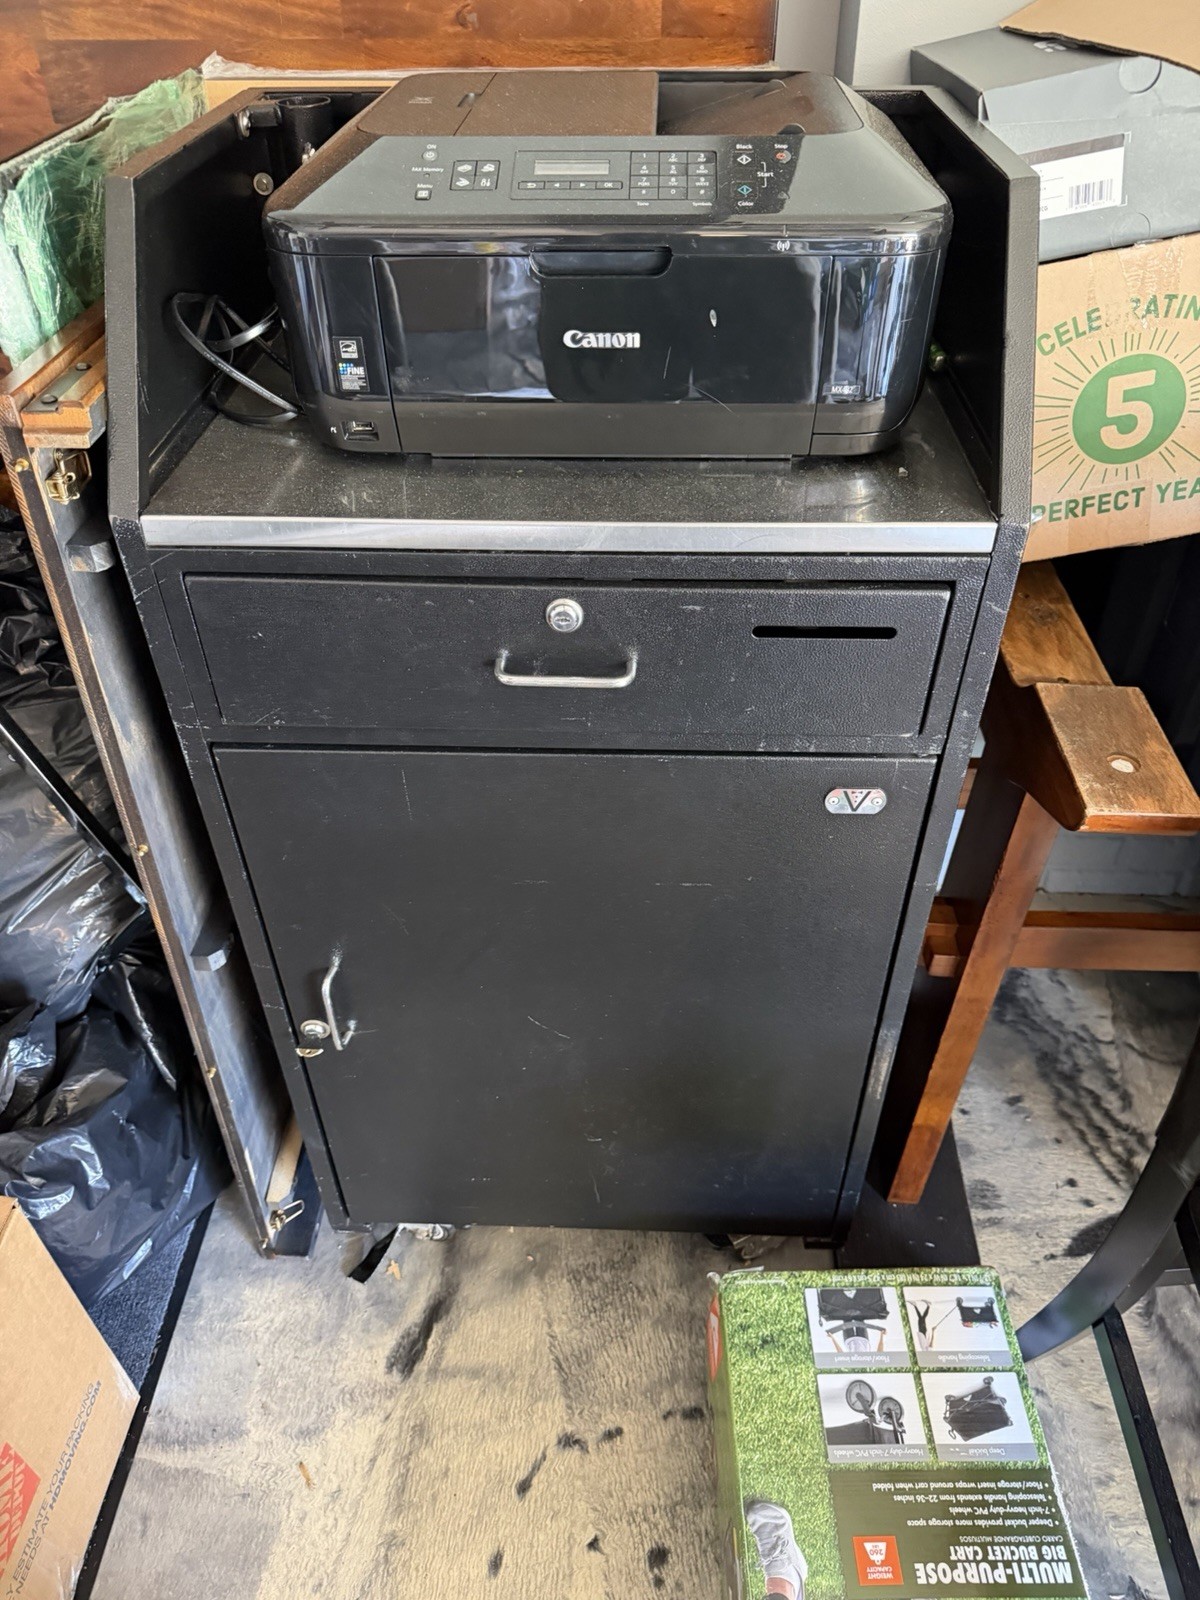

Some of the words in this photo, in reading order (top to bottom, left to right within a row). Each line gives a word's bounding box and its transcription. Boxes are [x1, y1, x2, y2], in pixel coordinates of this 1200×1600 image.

[563, 329, 640, 348] Canon
[348, 366, 365, 375] FINE
[1100, 369, 1156, 450] 5
[1032, 487, 1146, 524] PERFECT
[958, 1353, 991, 1362] Telescoping
[833, 1449, 854, 1457] wheels
[890, 1447, 924, 1456] Heavy-duty
[969, 1448, 988, 1456] bucket
[990, 1446, 1005, 1456] Deep
[13, 1499, 48, 1581] ESTIMATE
[46, 1450, 68, 1495] YOUR
[66, 1382, 94, 1448] PACKING
[955, 1480, 976, 1488] wraps
[977, 1482, 996, 1490] insert
[16, 1537, 42, 1594] NEEDS
[41, 1511, 50, 1535] AT
[49, 1380, 102, 1511] HDMOVING.COM
[872, 1483, 894, 1492] folded
[895, 1483, 914, 1491] when
[930, 1482, 954, 1491] around
[894, 1495, 915, 1504] inches
[939, 1495, 956, 1503] from
[956, 1494, 982, 1503] extends
[984, 1495, 1008, 1503] handle
[1008, 1492, 1047, 1502] Telescoping
[949, 1507, 973, 1515] wheels
[990, 1505, 1028, 1515] heavy-duty
[907, 1518, 927, 1526] space
[928, 1518, 954, 1527] storage
[974, 1517, 1003, 1528] provides
[1004, 1519, 1028, 1528] bucket
[1028, 1517, 1053, 1527] Deeper
[959, 1535, 992, 1543] MULTIUSOS
[950, 1545, 983, 1560] CART
[987, 1545, 1038, 1560] BUCKET
[1041, 1545, 1067, 1560] BIG
[913, 1562, 1074, 1585] MULTI-PURPOSE
